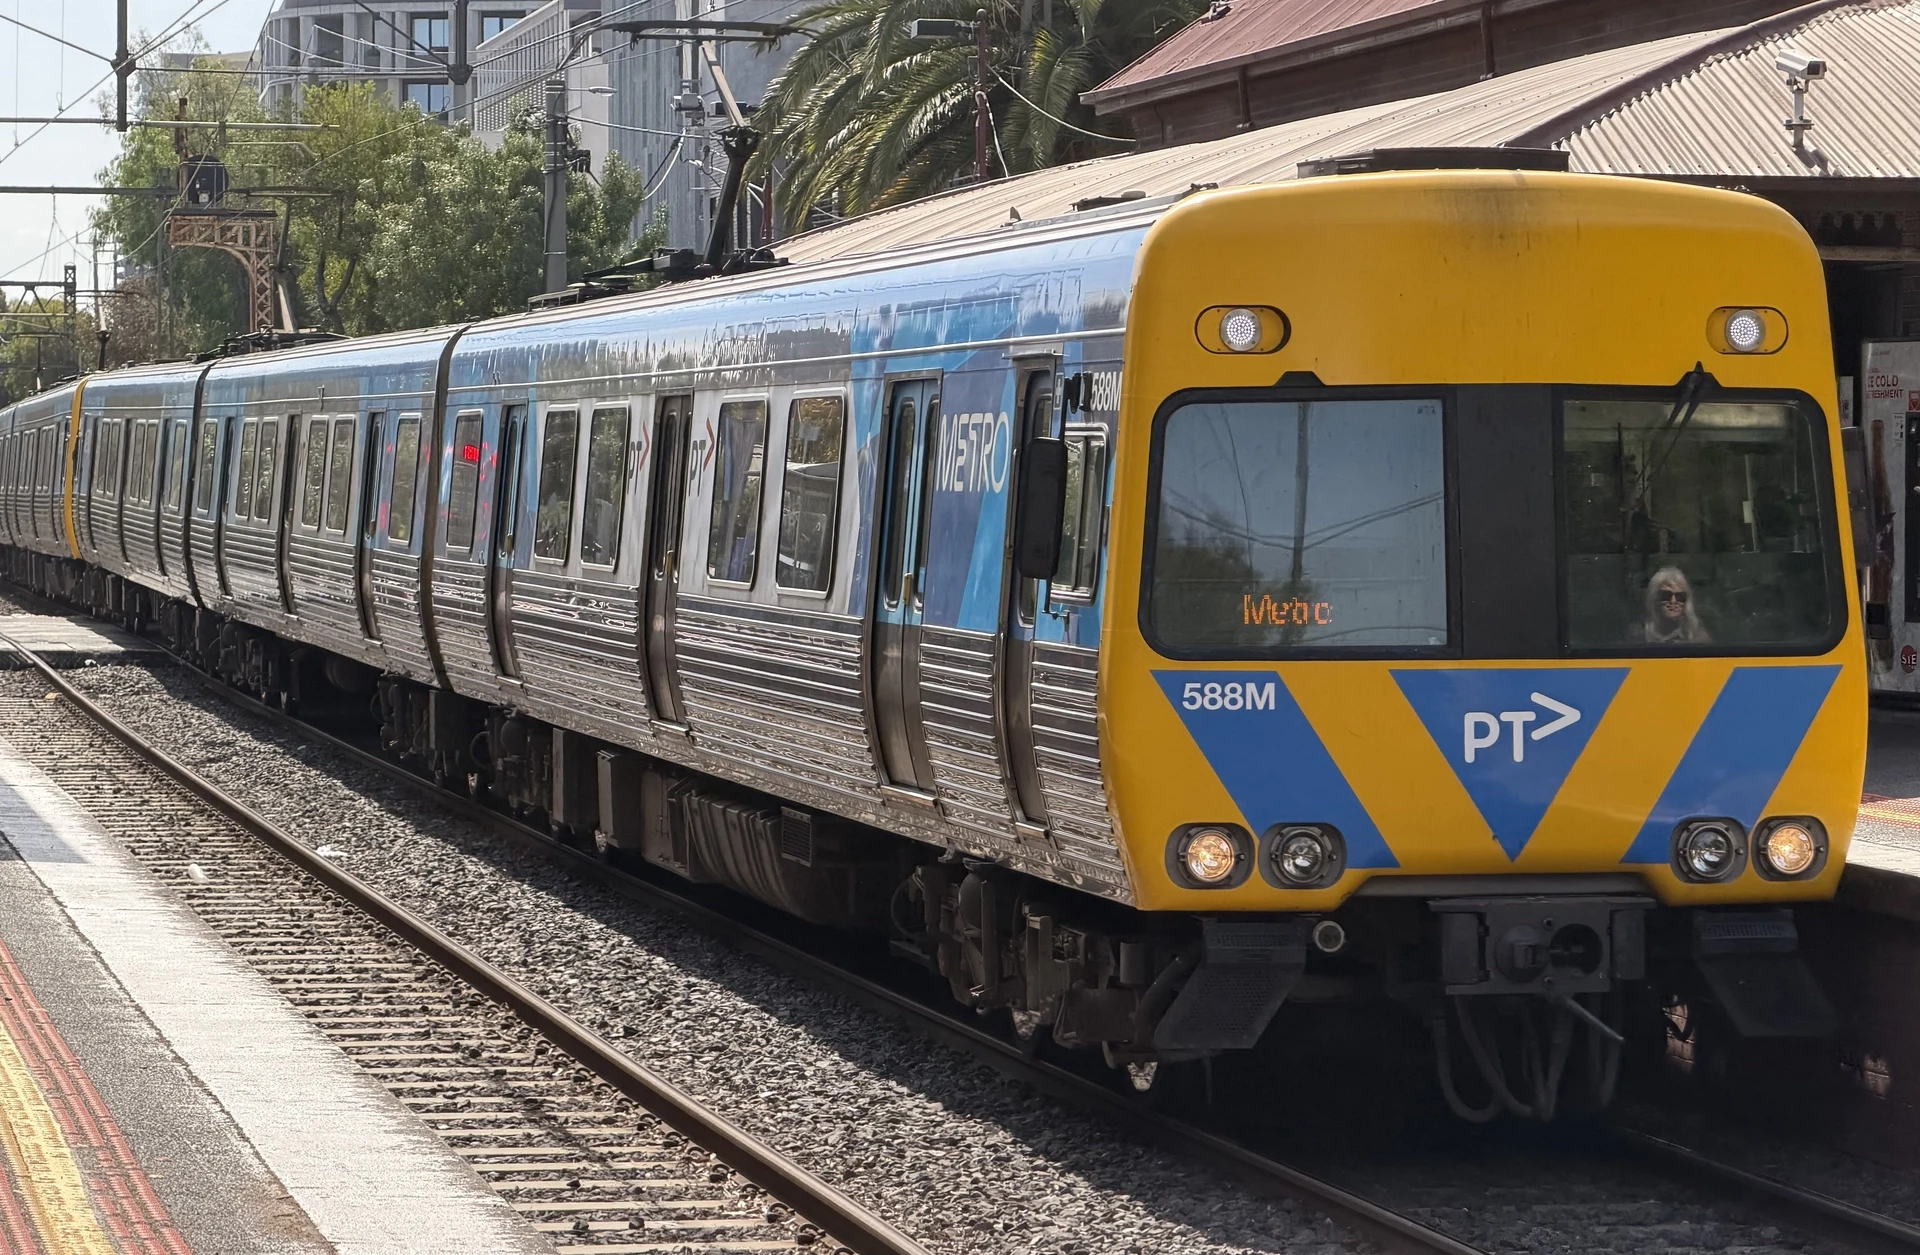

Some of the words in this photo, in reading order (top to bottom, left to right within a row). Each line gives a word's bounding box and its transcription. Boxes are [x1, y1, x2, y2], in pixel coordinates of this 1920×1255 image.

[1090, 370, 1122, 412] 588M
[1875, 375, 1899, 388] COLD
[936, 411, 1010, 494] METRO
[1182, 682, 1276, 711] 588M
